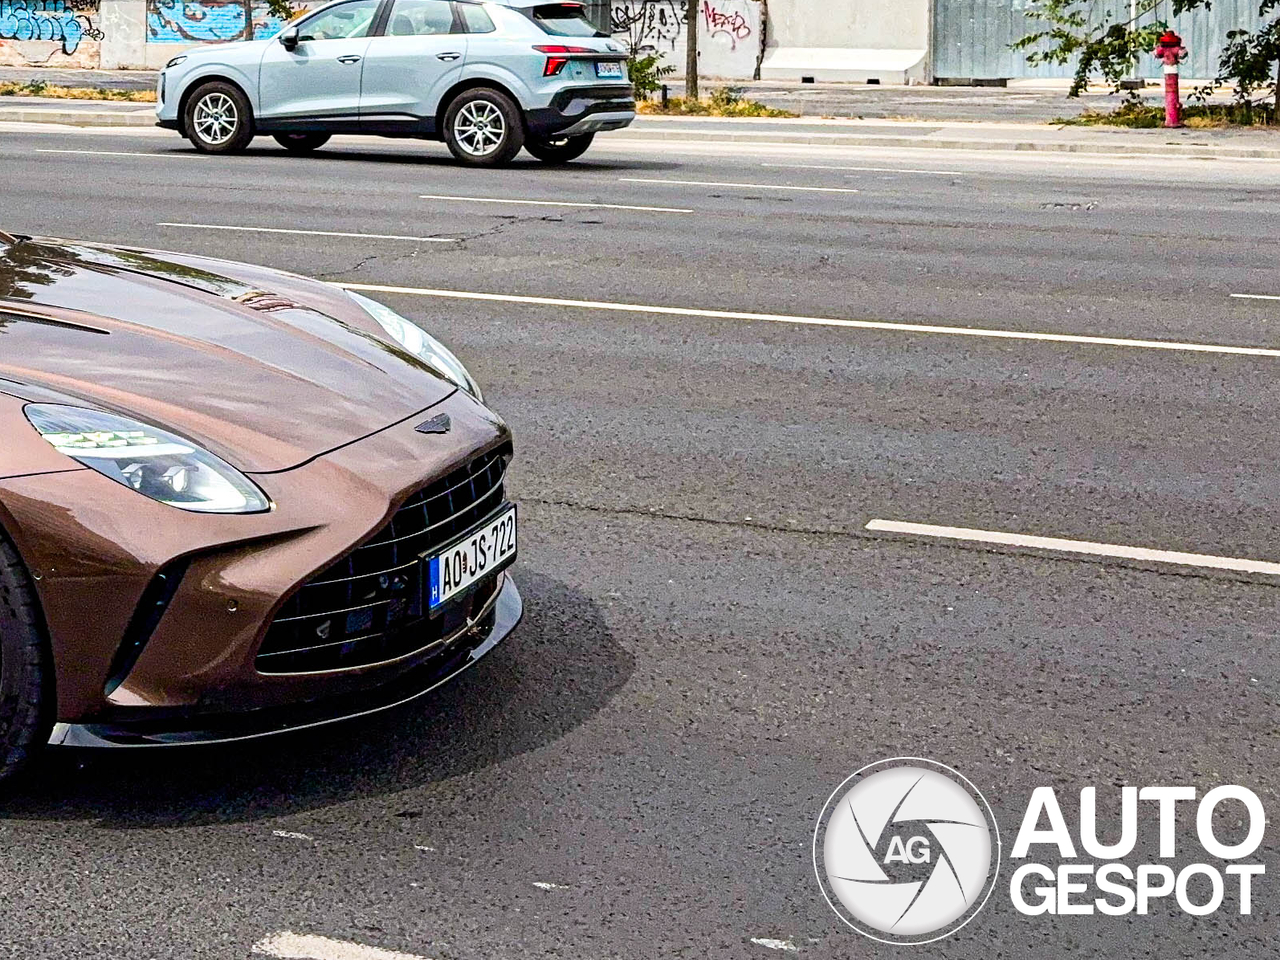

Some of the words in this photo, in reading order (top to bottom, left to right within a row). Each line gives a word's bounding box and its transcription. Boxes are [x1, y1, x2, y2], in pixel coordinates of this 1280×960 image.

[442, 550, 462, 595] AO
[470, 515, 514, 577] JS-722
[432, 586, 438, 601] H
